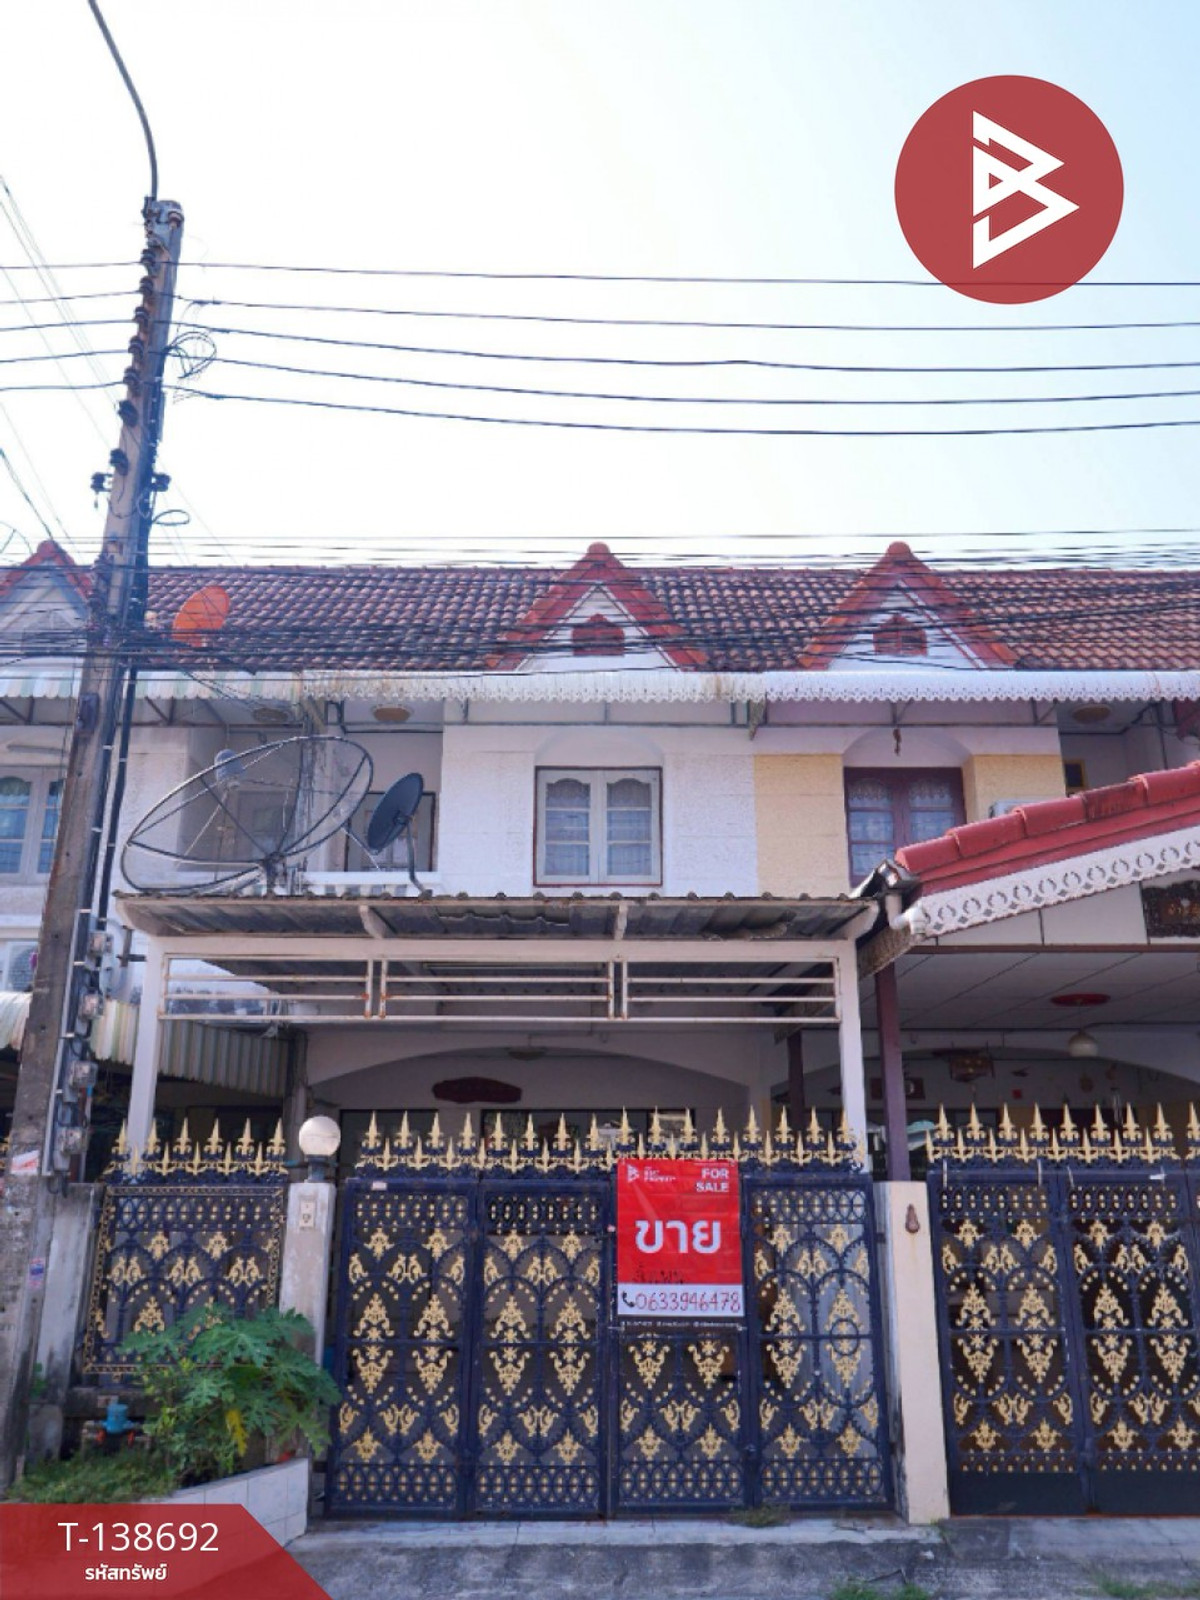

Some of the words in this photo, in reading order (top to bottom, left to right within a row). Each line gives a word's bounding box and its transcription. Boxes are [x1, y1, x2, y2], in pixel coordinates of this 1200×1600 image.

[701, 1167, 730, 1179] FOR
[695, 1181, 730, 1193] SALE
[634, 1220, 722, 1254] ขาย
